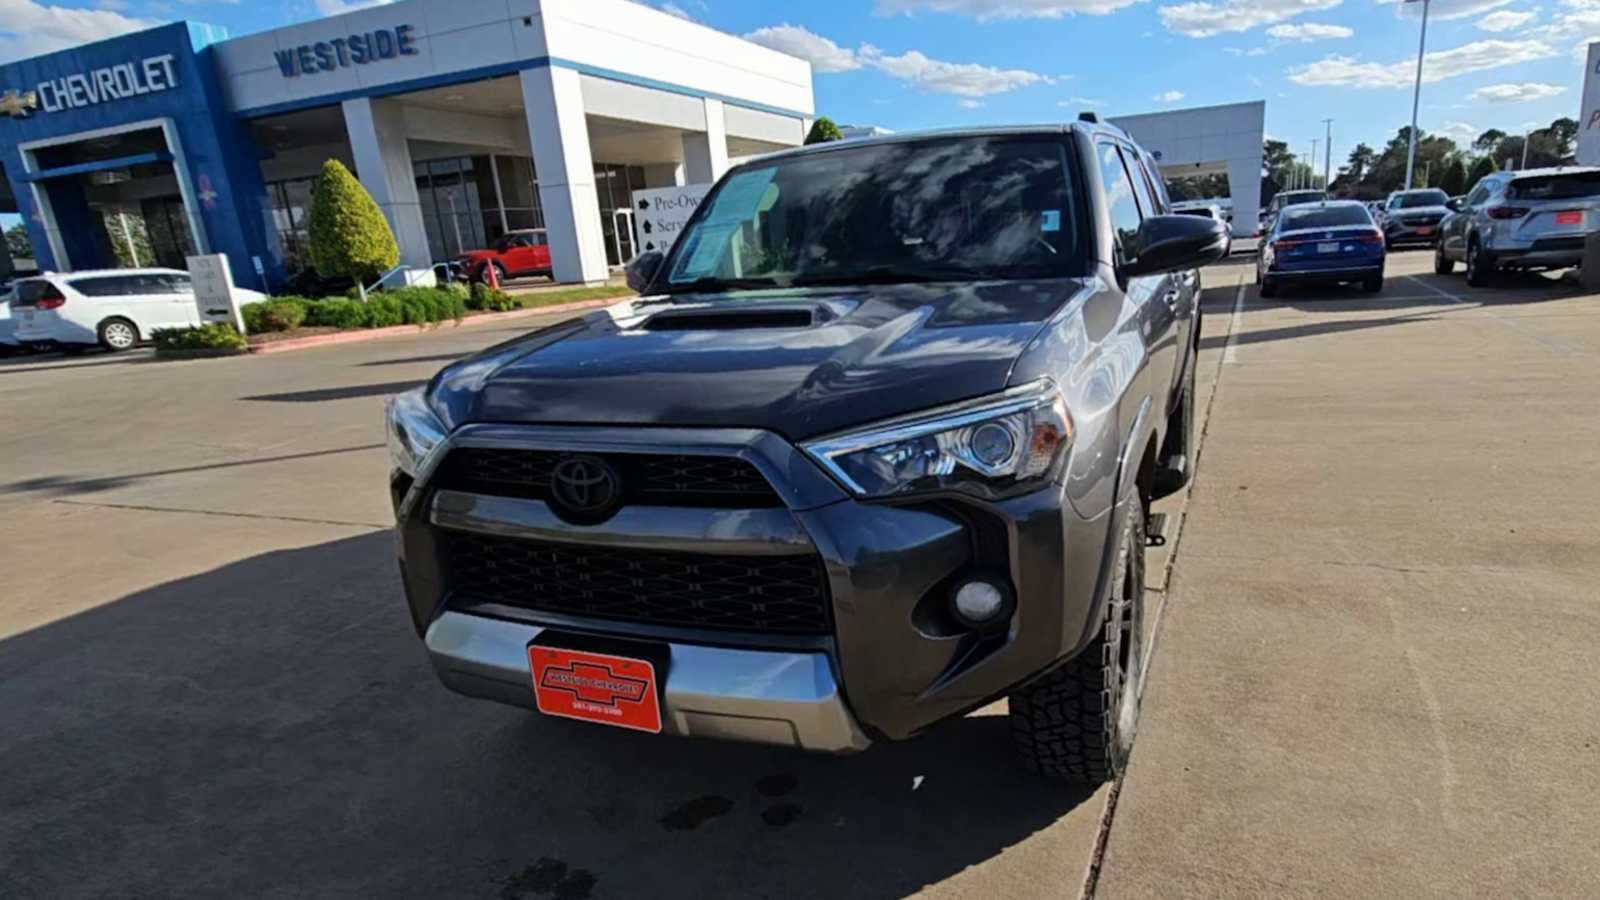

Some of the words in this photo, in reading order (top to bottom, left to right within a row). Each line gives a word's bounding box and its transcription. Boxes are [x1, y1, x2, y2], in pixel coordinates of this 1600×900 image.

[273, 24, 419, 77] WESTSIDE
[37, 53, 177, 113] CHEVROLET
[654, 194, 704, 211] Pre-Ow
[657, 218, 686, 232] Serv
